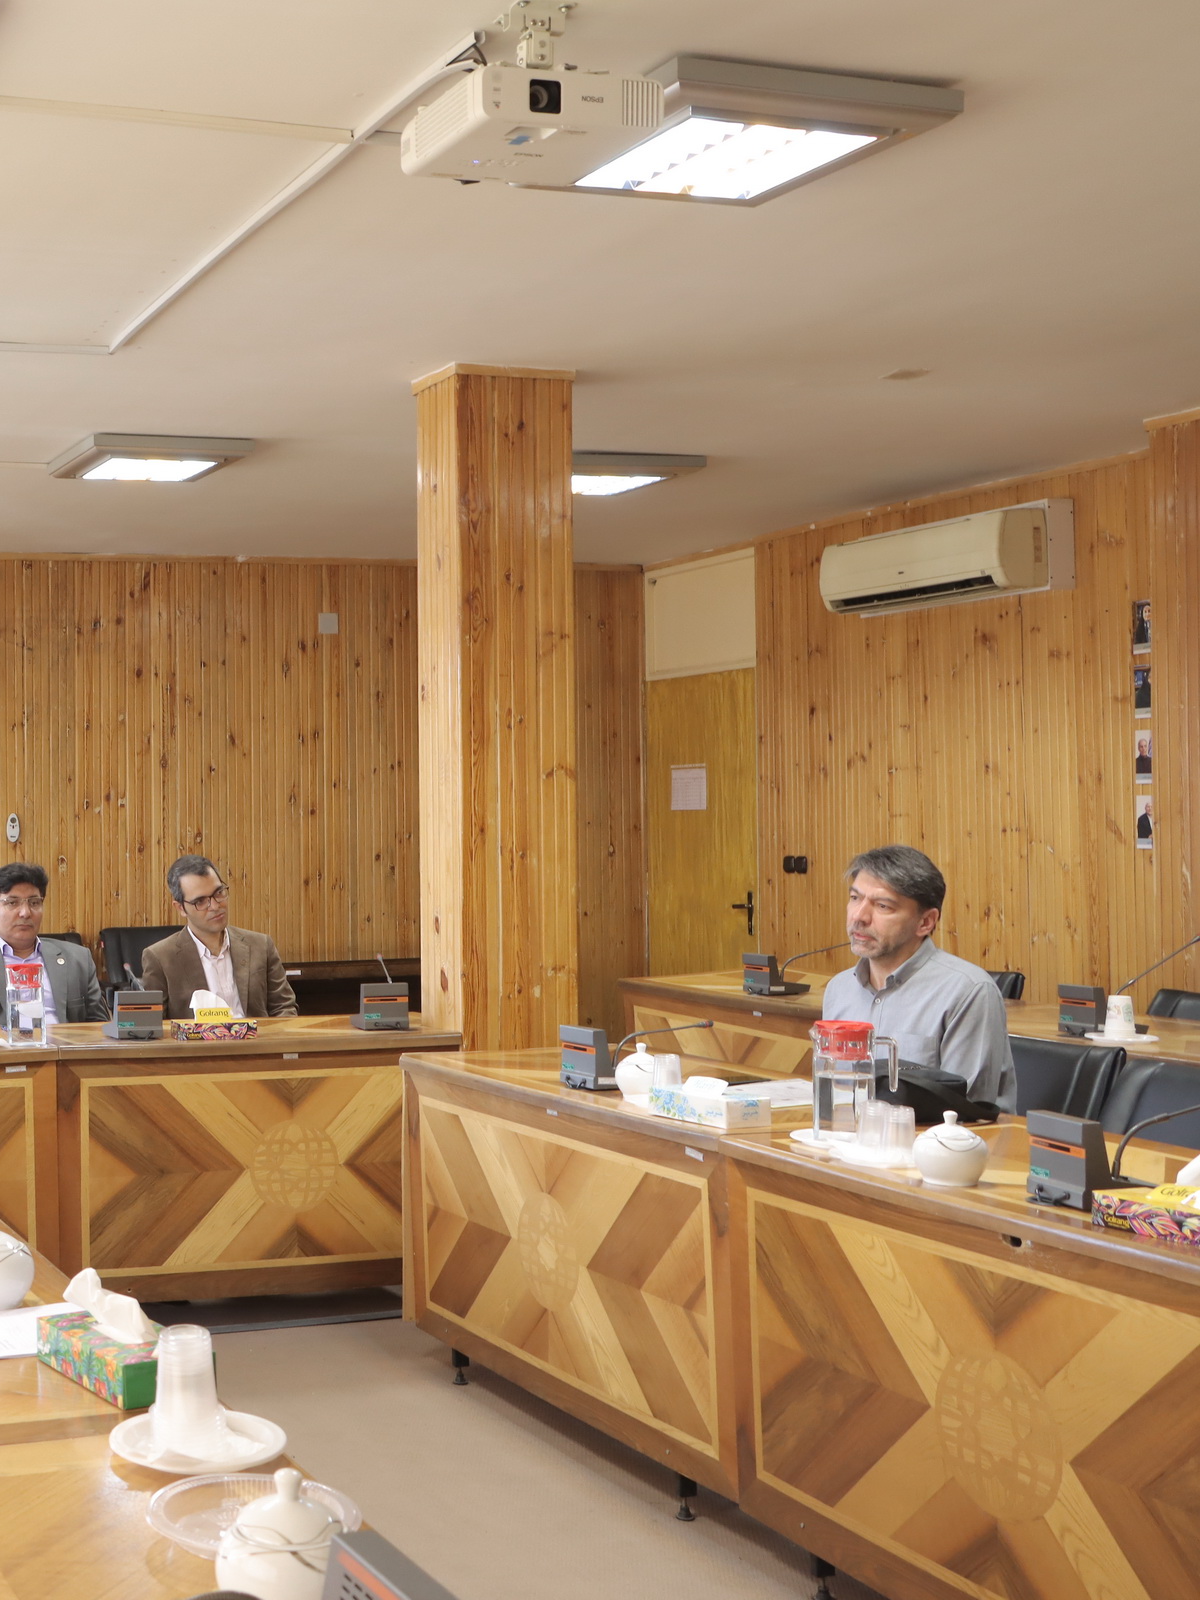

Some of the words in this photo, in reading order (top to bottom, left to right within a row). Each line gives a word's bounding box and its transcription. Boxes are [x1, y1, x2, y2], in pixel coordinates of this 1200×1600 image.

[581, 95, 604, 103] EPSON
[199, 1010, 229, 1018] Golrang
[1103, 1214, 1130, 1228] Golrang
